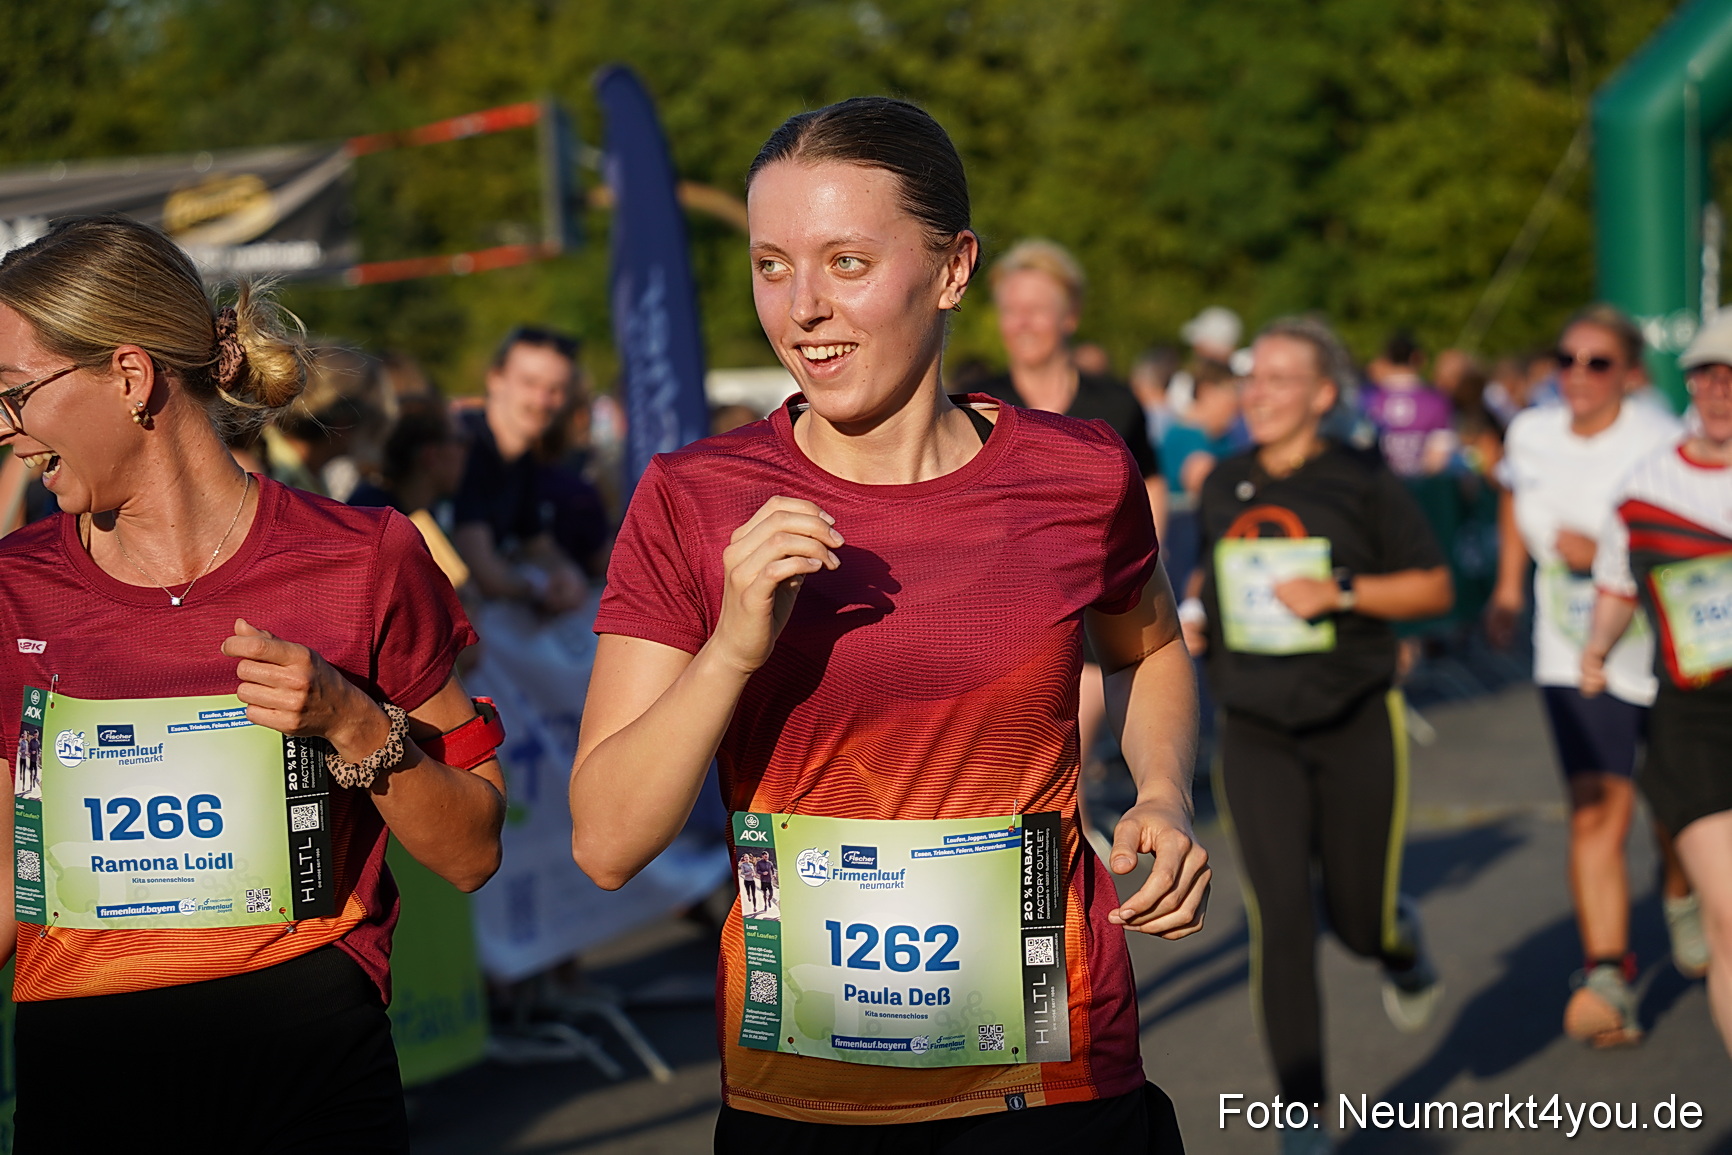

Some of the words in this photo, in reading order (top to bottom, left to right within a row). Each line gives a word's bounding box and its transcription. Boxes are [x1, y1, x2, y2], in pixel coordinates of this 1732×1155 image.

[24, 705, 42, 720] AOK
[103, 732, 132, 740] Fischer
[89, 743, 164, 759] Firmenlauf
[118, 754, 164, 766] neumarkt
[287, 760, 297, 771] %
[300, 745, 310, 789] FACTORY
[288, 772, 298, 791] 20
[84, 794, 223, 841] 1266
[739, 829, 768, 842] AOK
[974, 843, 1006, 852] Netzwerken
[1036, 829, 1044, 870] OUTLET
[91, 855, 179, 873] Ramona
[184, 852, 233, 870] Loidl
[846, 853, 875, 862] Fischer
[1024, 829, 1033, 885] RABATT
[298, 836, 316, 903] HILTL
[832, 868, 906, 881] Firmenlauf
[146, 876, 195, 884] sonnenschloss
[859, 881, 904, 890] neumarkt
[1023, 888, 1033, 899] %
[1036, 872, 1045, 920] FACTORY
[100, 905, 175, 917] firmenlauf.bayern
[197, 903, 233, 911] Firmenlauf
[1023, 901, 1033, 921] 20
[757, 932, 778, 940] Laufen?
[825, 920, 960, 972] 1262
[844, 983, 903, 1006] Paula
[909, 986, 951, 1006] Deß
[865, 1010, 878, 1018] Kita
[879, 1011, 928, 1020] sonnenschloss
[1032, 972, 1049, 1045] HILTL
[835, 1038, 907, 1051] firmenlauf.bayern
[930, 1039, 965, 1049] Firmenlauf
